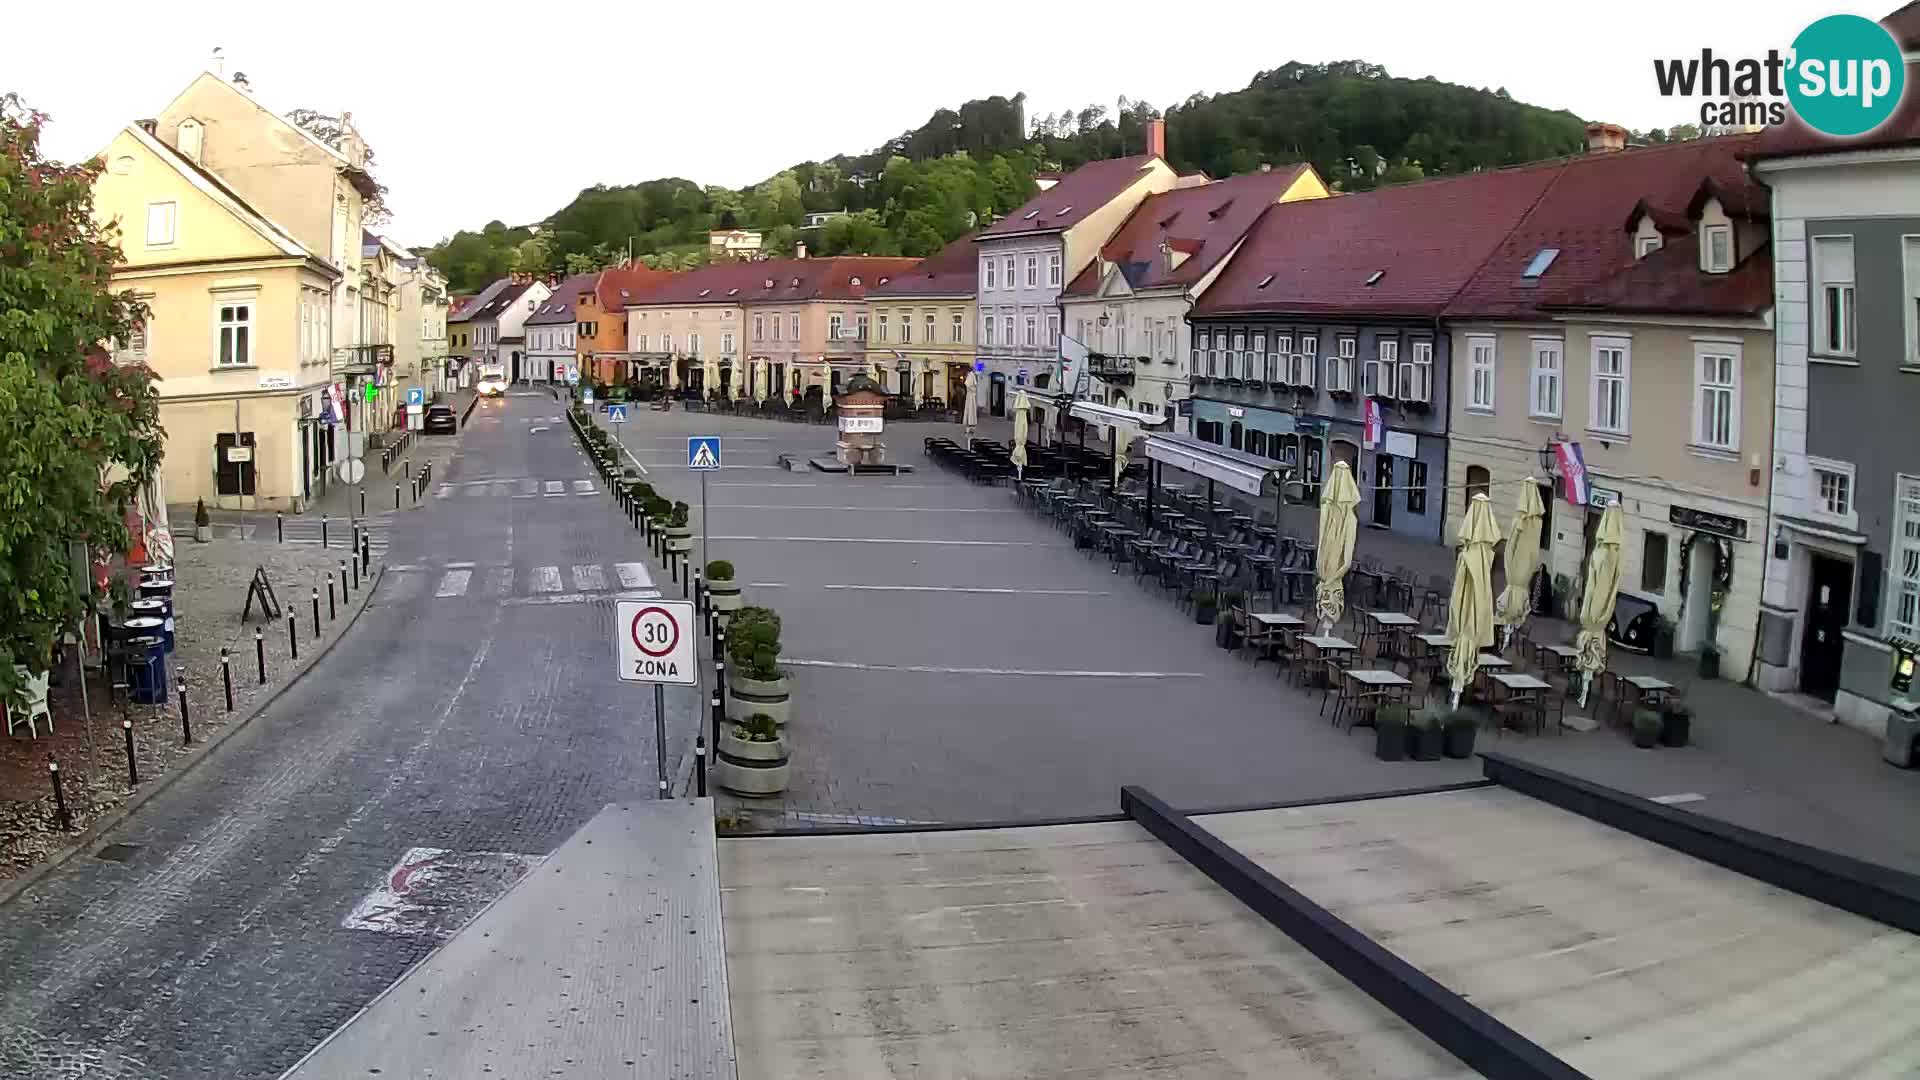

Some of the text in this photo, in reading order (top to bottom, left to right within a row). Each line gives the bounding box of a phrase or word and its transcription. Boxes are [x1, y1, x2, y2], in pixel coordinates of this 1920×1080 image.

[411, 391, 419, 402] P
[644, 623, 668, 643] 30
[635, 660, 678, 677] ZONA
